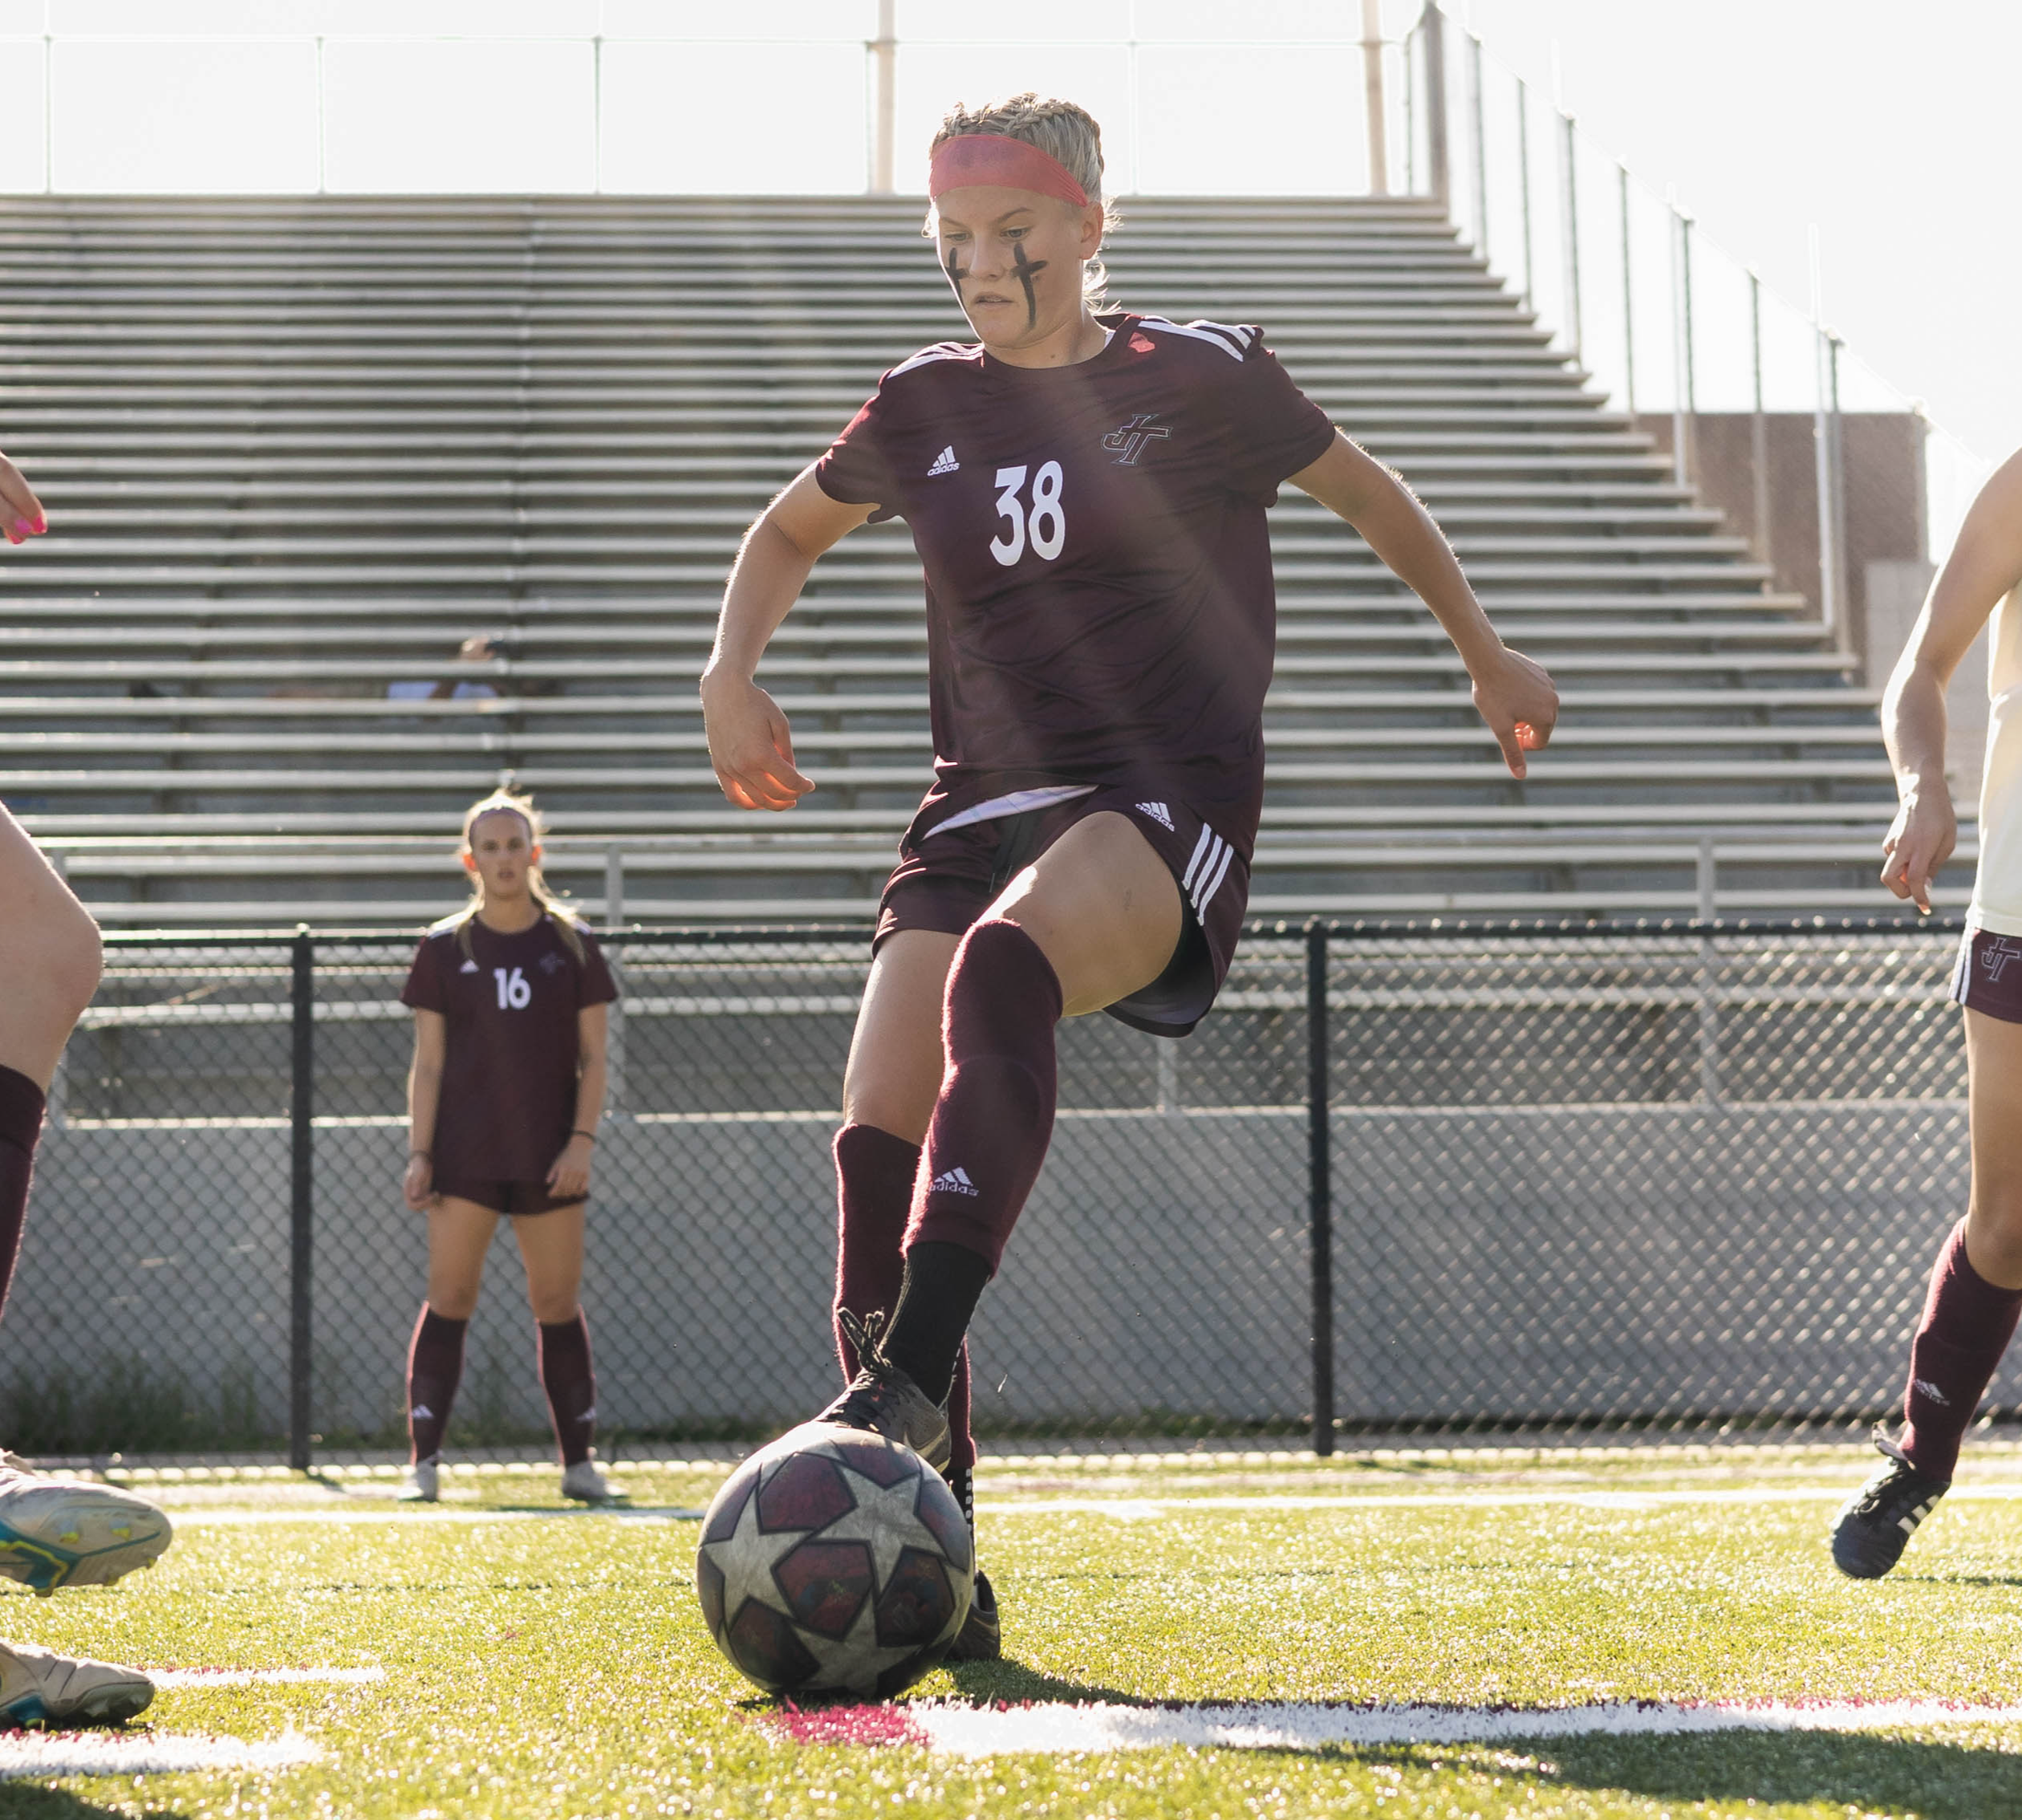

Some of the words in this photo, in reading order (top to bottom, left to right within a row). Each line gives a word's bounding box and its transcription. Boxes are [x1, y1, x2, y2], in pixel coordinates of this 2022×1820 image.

[927, 462, 960, 477] adidas
[989, 460, 1066, 567] 38
[1135, 803, 1175, 832] adidas
[493, 966, 531, 1010] 16
[929, 1180, 980, 1196] adidas
